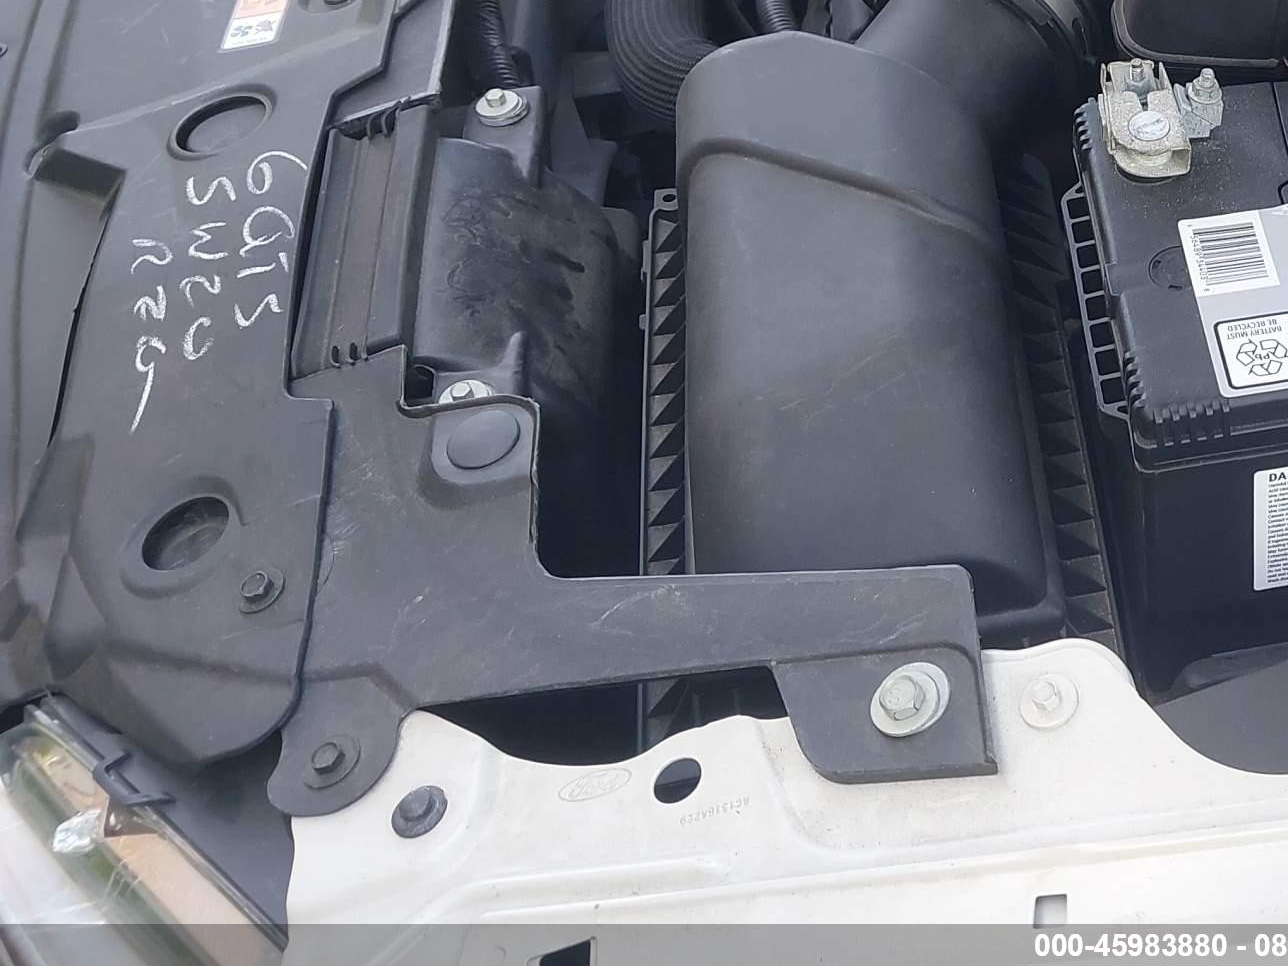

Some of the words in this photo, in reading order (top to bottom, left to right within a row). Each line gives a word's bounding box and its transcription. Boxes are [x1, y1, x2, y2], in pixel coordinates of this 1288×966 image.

[1226, 319, 1266, 331] RECYCLED
[1248, 324, 1282, 336] BATTERY
[1224, 330, 1249, 340] MUST
